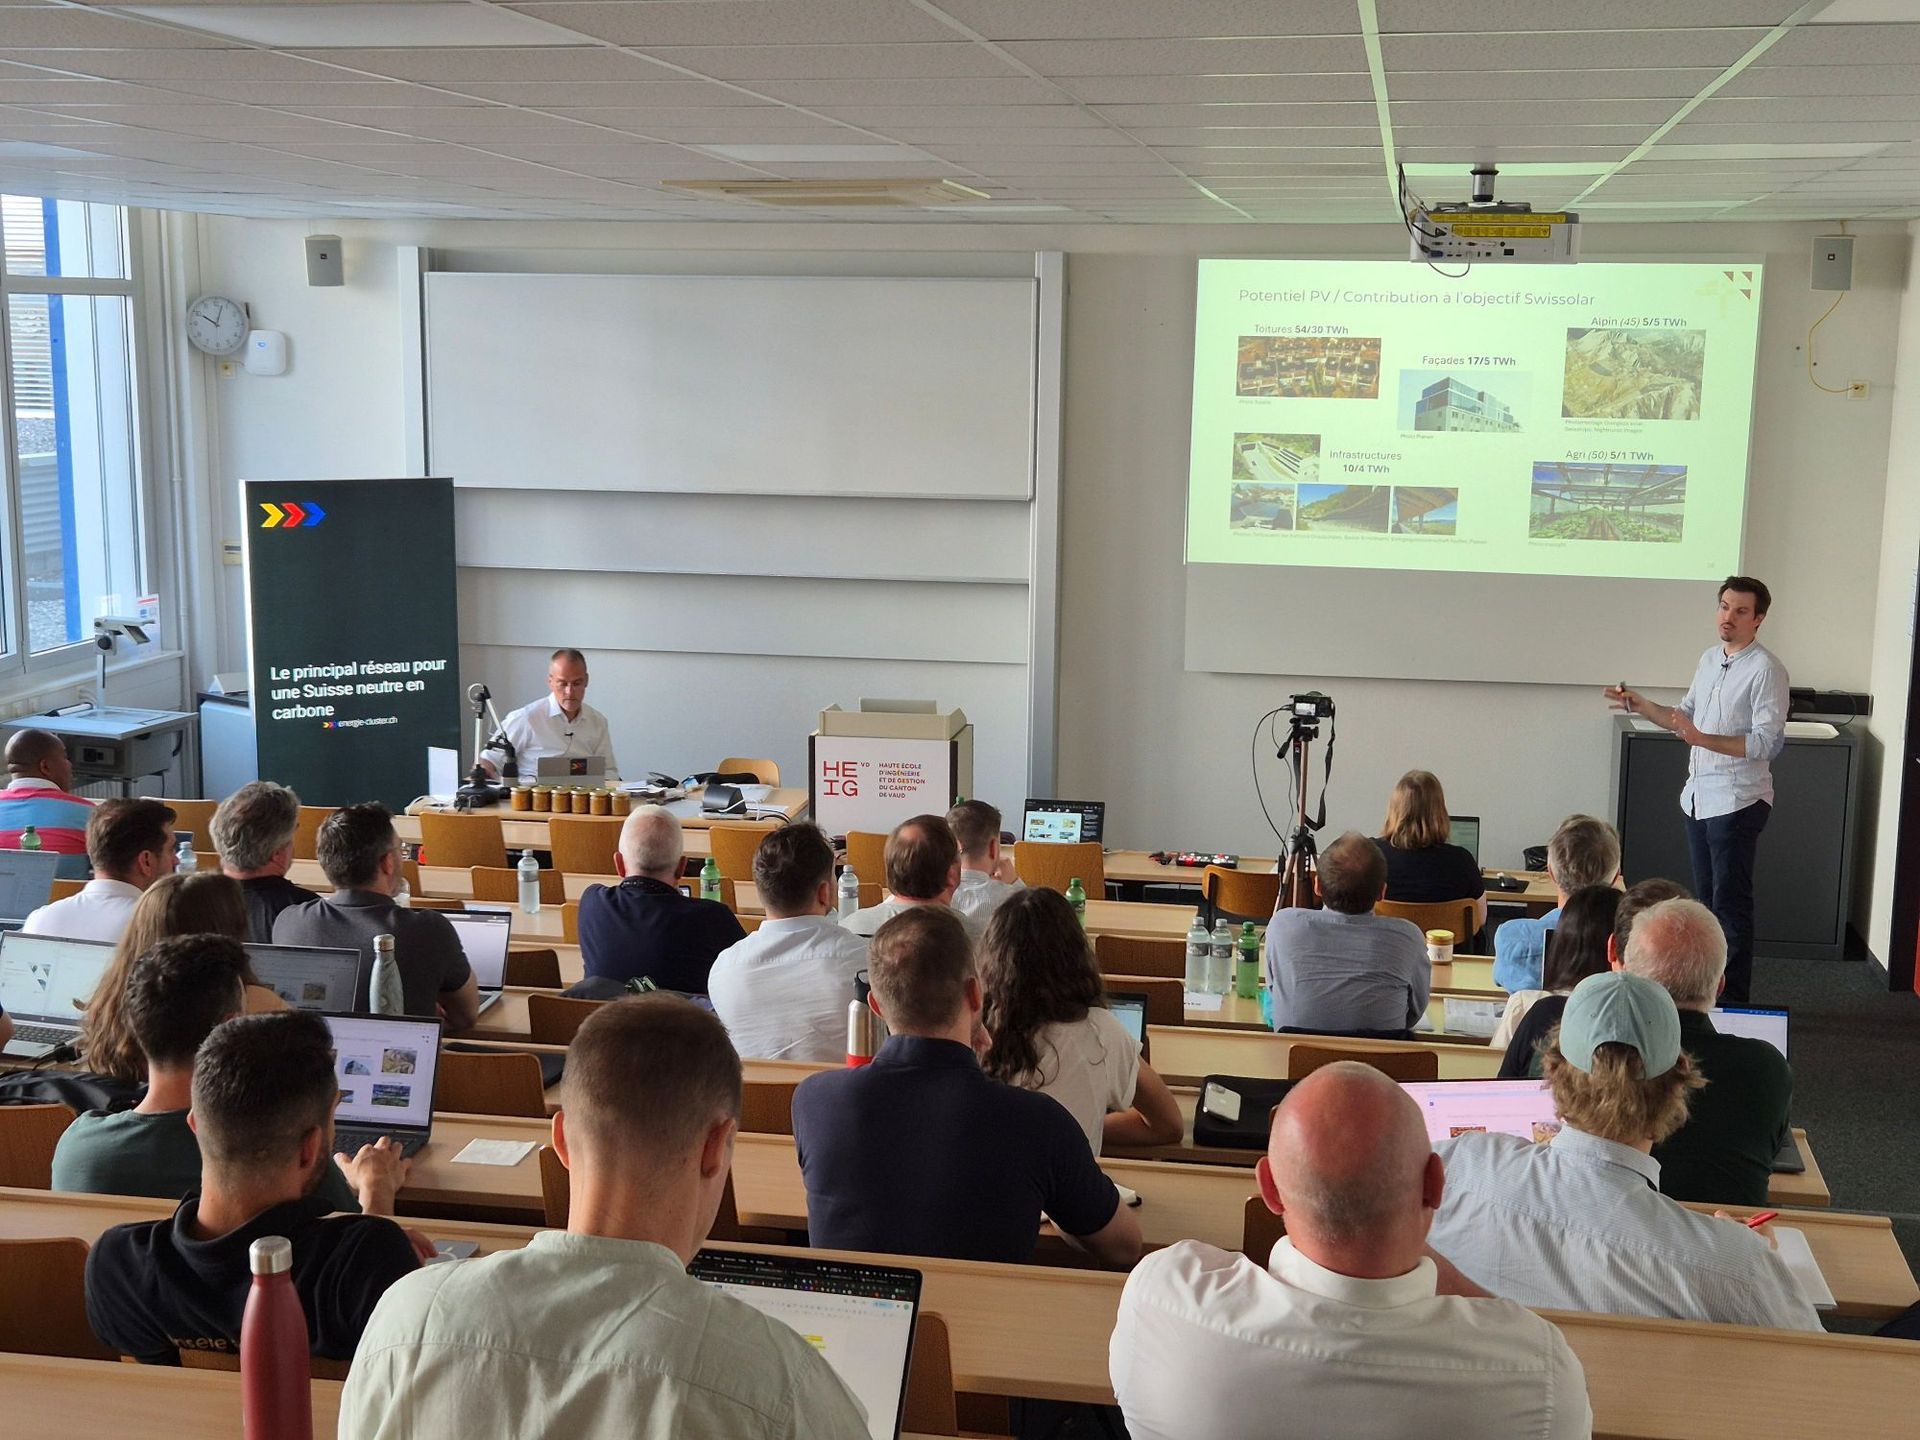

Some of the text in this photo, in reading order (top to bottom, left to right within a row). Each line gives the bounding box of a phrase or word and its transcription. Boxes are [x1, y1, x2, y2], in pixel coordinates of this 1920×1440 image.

[1239, 289, 1305, 302] Potentiel
[1311, 290, 1331, 302] PV
[1333, 289, 1340, 303] /
[1343, 290, 1438, 304] Contribution
[1456, 292, 1521, 307] l'objectif
[1524, 292, 1595, 306] Swissolar
[1591, 317, 1687, 327] Alpin (45) 5/5 TWh
[1254, 324, 1349, 335] Toitures 54/30 TWh
[1422, 355, 1516, 367] Façades 17/5 TWh
[1329, 450, 1402, 461] Infrastructures
[1565, 450, 1654, 461] Agri (50) 5/1 TWh
[1343, 464, 1390, 474] 10/4 TWh
[270, 659, 447, 682] Le principal réseau pour
[271, 679, 425, 701] une Suisse neutre en
[271, 704, 335, 720] carbone
[338, 716, 398, 728] energie-cluster.ch
[823, 760, 858, 778] HE
[823, 780, 858, 797] IG
